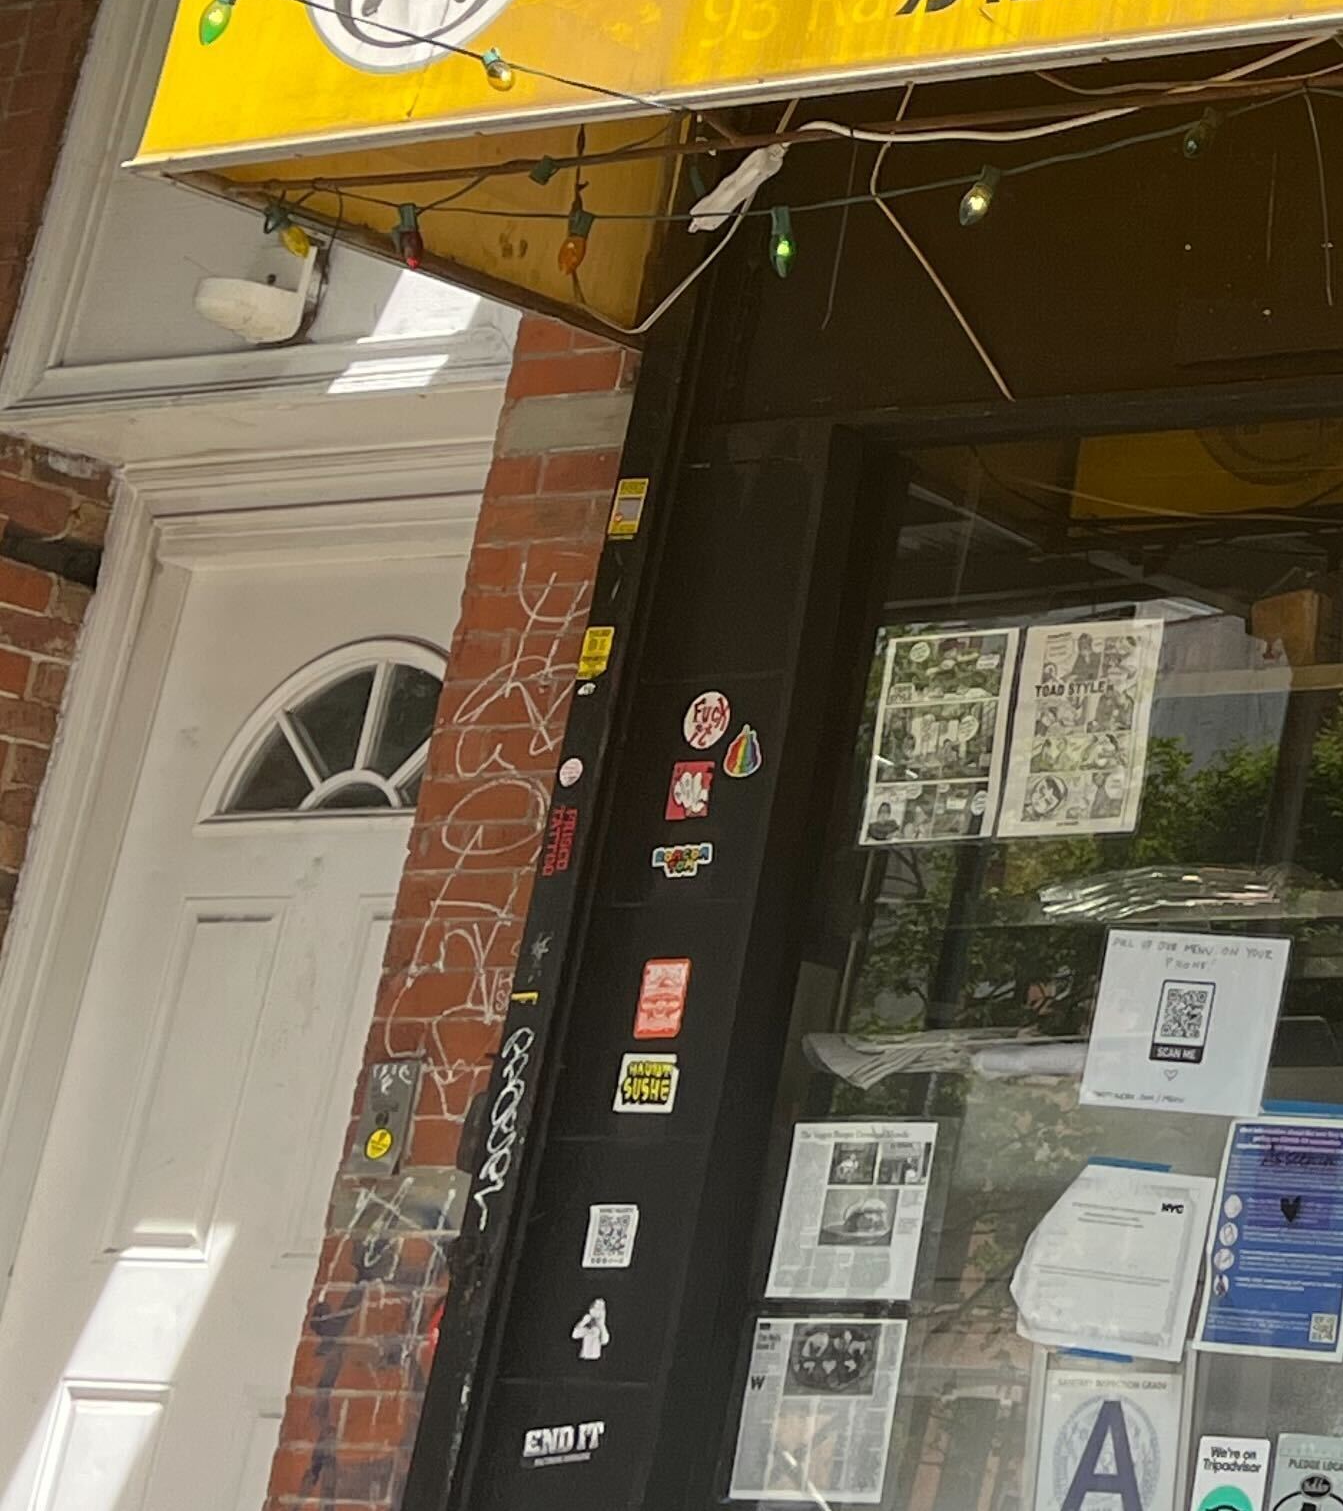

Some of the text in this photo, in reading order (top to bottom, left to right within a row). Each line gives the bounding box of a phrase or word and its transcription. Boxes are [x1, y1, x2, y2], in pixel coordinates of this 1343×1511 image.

[1035, 684, 1065, 697] TOAD
[1184, 943, 1214, 956] MENU
[1157, 1047, 1197, 1060] SCAN ME
[1161, 1202, 1185, 1214] NYC
[523, 1421, 605, 1457] END IT
[1059, 1400, 1145, 1511] A
[1210, 1446, 1257, 1460] We're on
[1203, 1458, 1262, 1473] Tripadvisor
